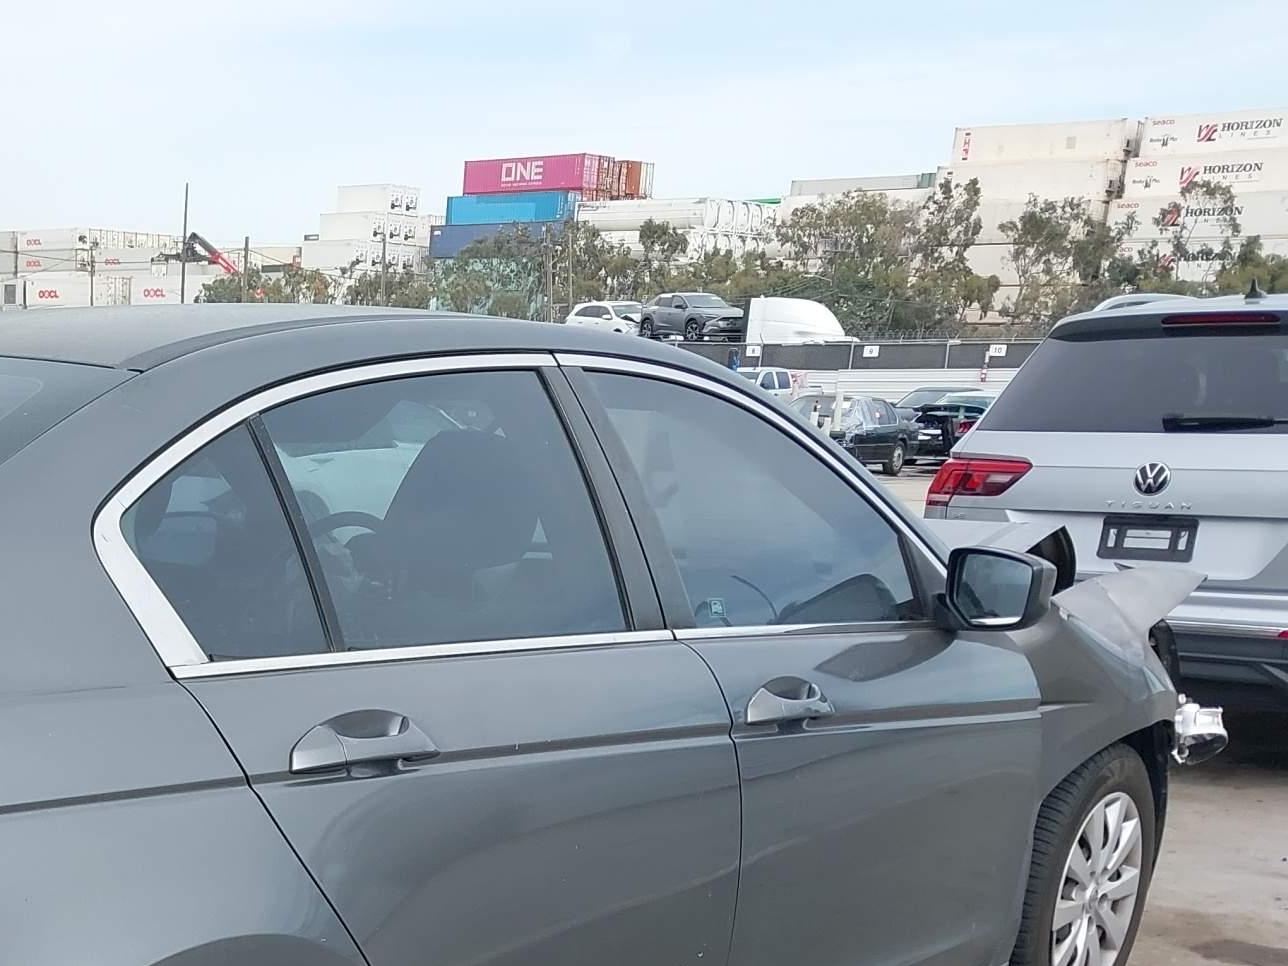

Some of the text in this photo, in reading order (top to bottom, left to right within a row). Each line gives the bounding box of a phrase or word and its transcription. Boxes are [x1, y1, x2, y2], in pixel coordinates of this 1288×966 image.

[1221, 118, 1283, 132] HORIZON
[1219, 130, 1271, 138] LINES
[501, 160, 543, 181] ONE
[1203, 162, 1264, 175] HORIZON
[1185, 206, 1243, 217] HORIZON
[38, 290, 59, 299] OOCL
[144, 288, 166, 298] OOCL
[1104, 499, 1193, 511] TIGUAN
